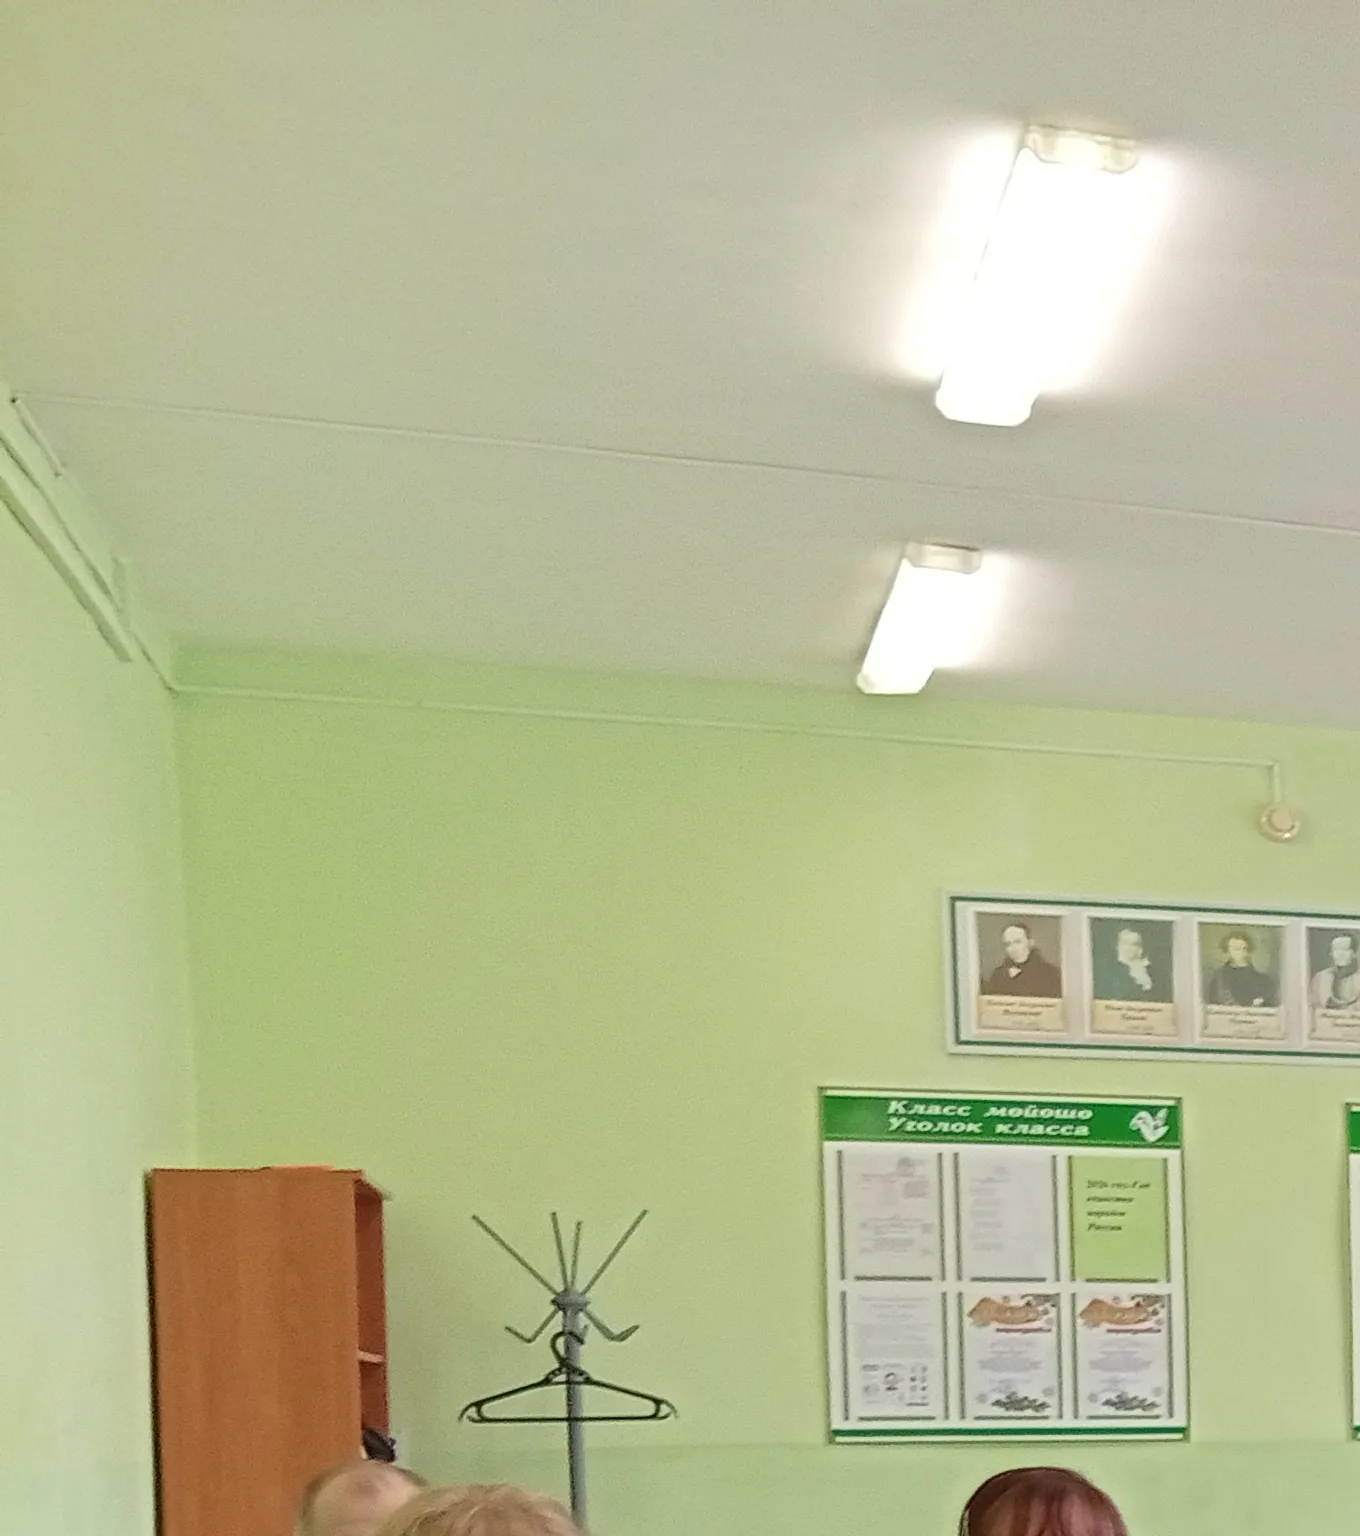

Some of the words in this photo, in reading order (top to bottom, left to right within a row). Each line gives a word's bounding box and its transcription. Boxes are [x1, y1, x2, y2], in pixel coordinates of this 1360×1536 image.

[887, 1100, 972, 1117] Класс
[888, 1117, 983, 1133] Уголок
[995, 1123, 1091, 1137] класса
